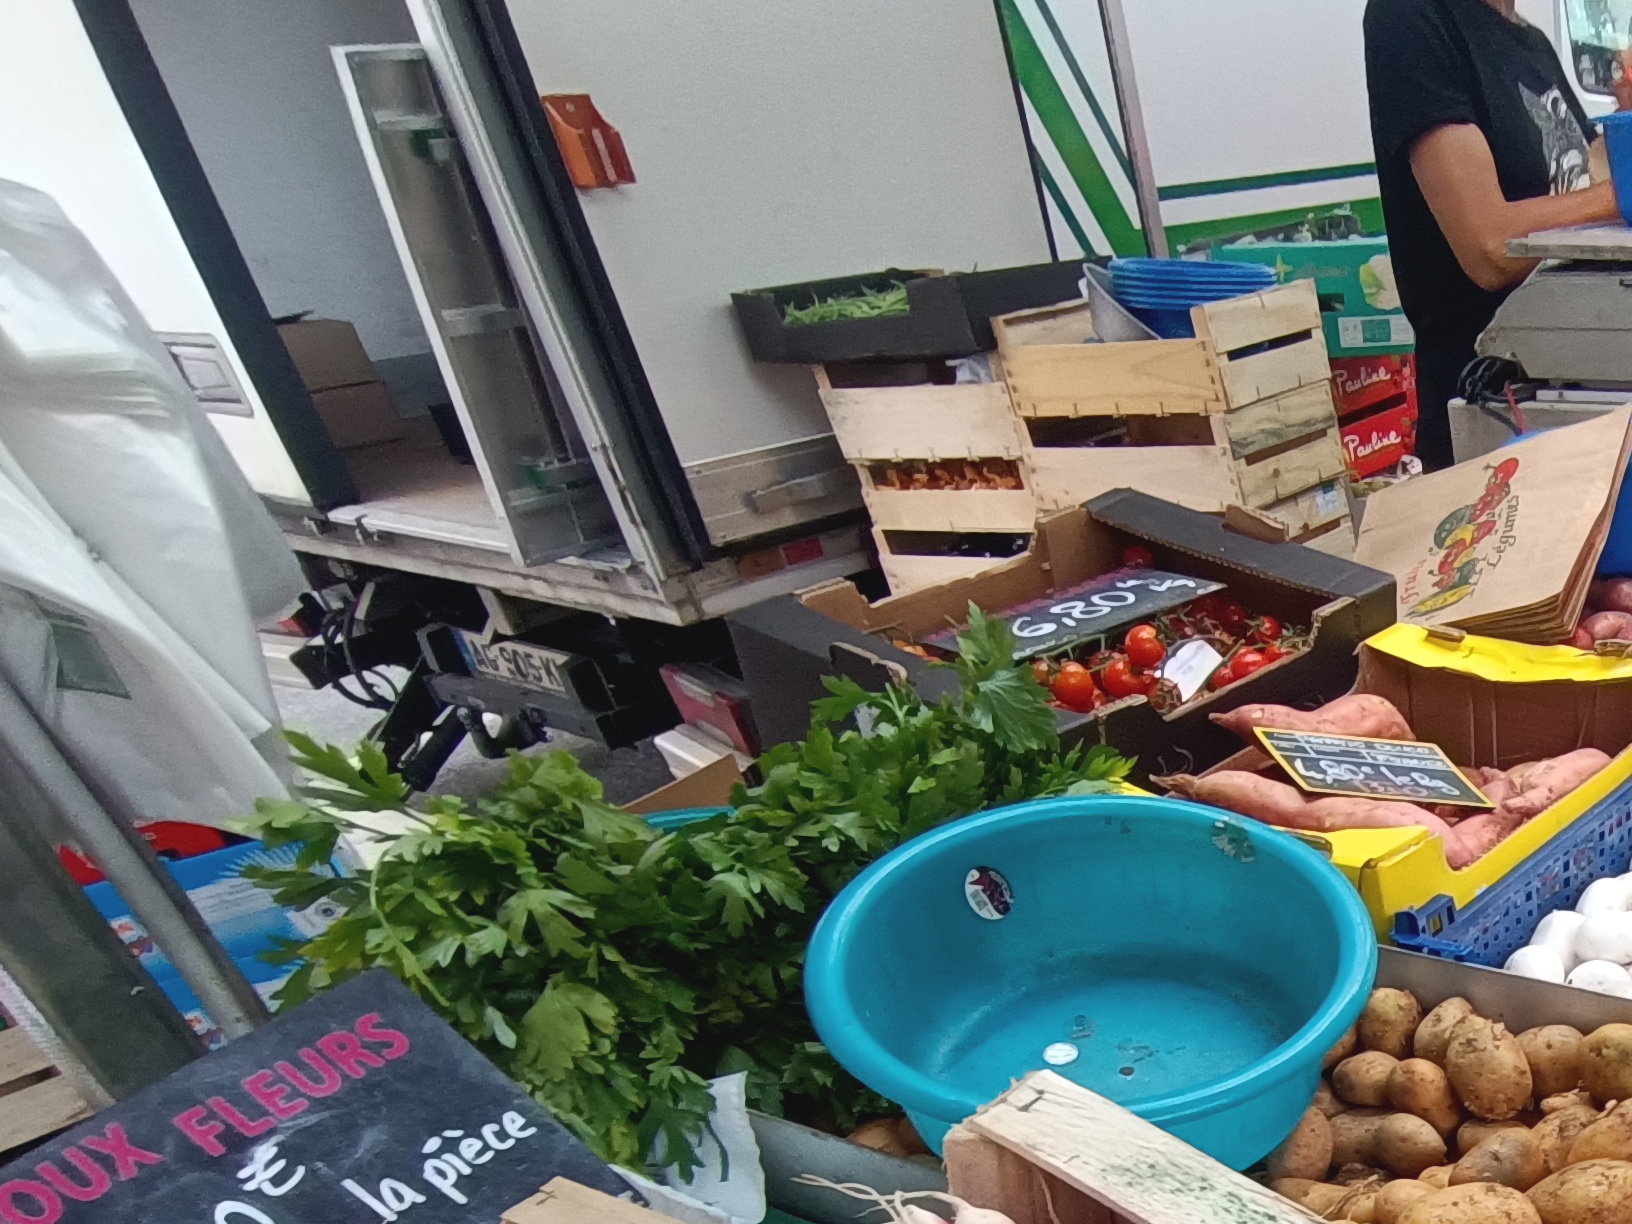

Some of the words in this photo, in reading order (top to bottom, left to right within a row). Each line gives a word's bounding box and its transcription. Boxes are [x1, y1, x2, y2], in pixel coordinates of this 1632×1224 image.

[1333, 366, 1391, 396] Pauline
[1343, 430, 1401, 461] Pauline
[173, 1012, 411, 1156] FLEURS
[341, 1178, 427, 1221] la
[421, 1110, 538, 1204] pièce
